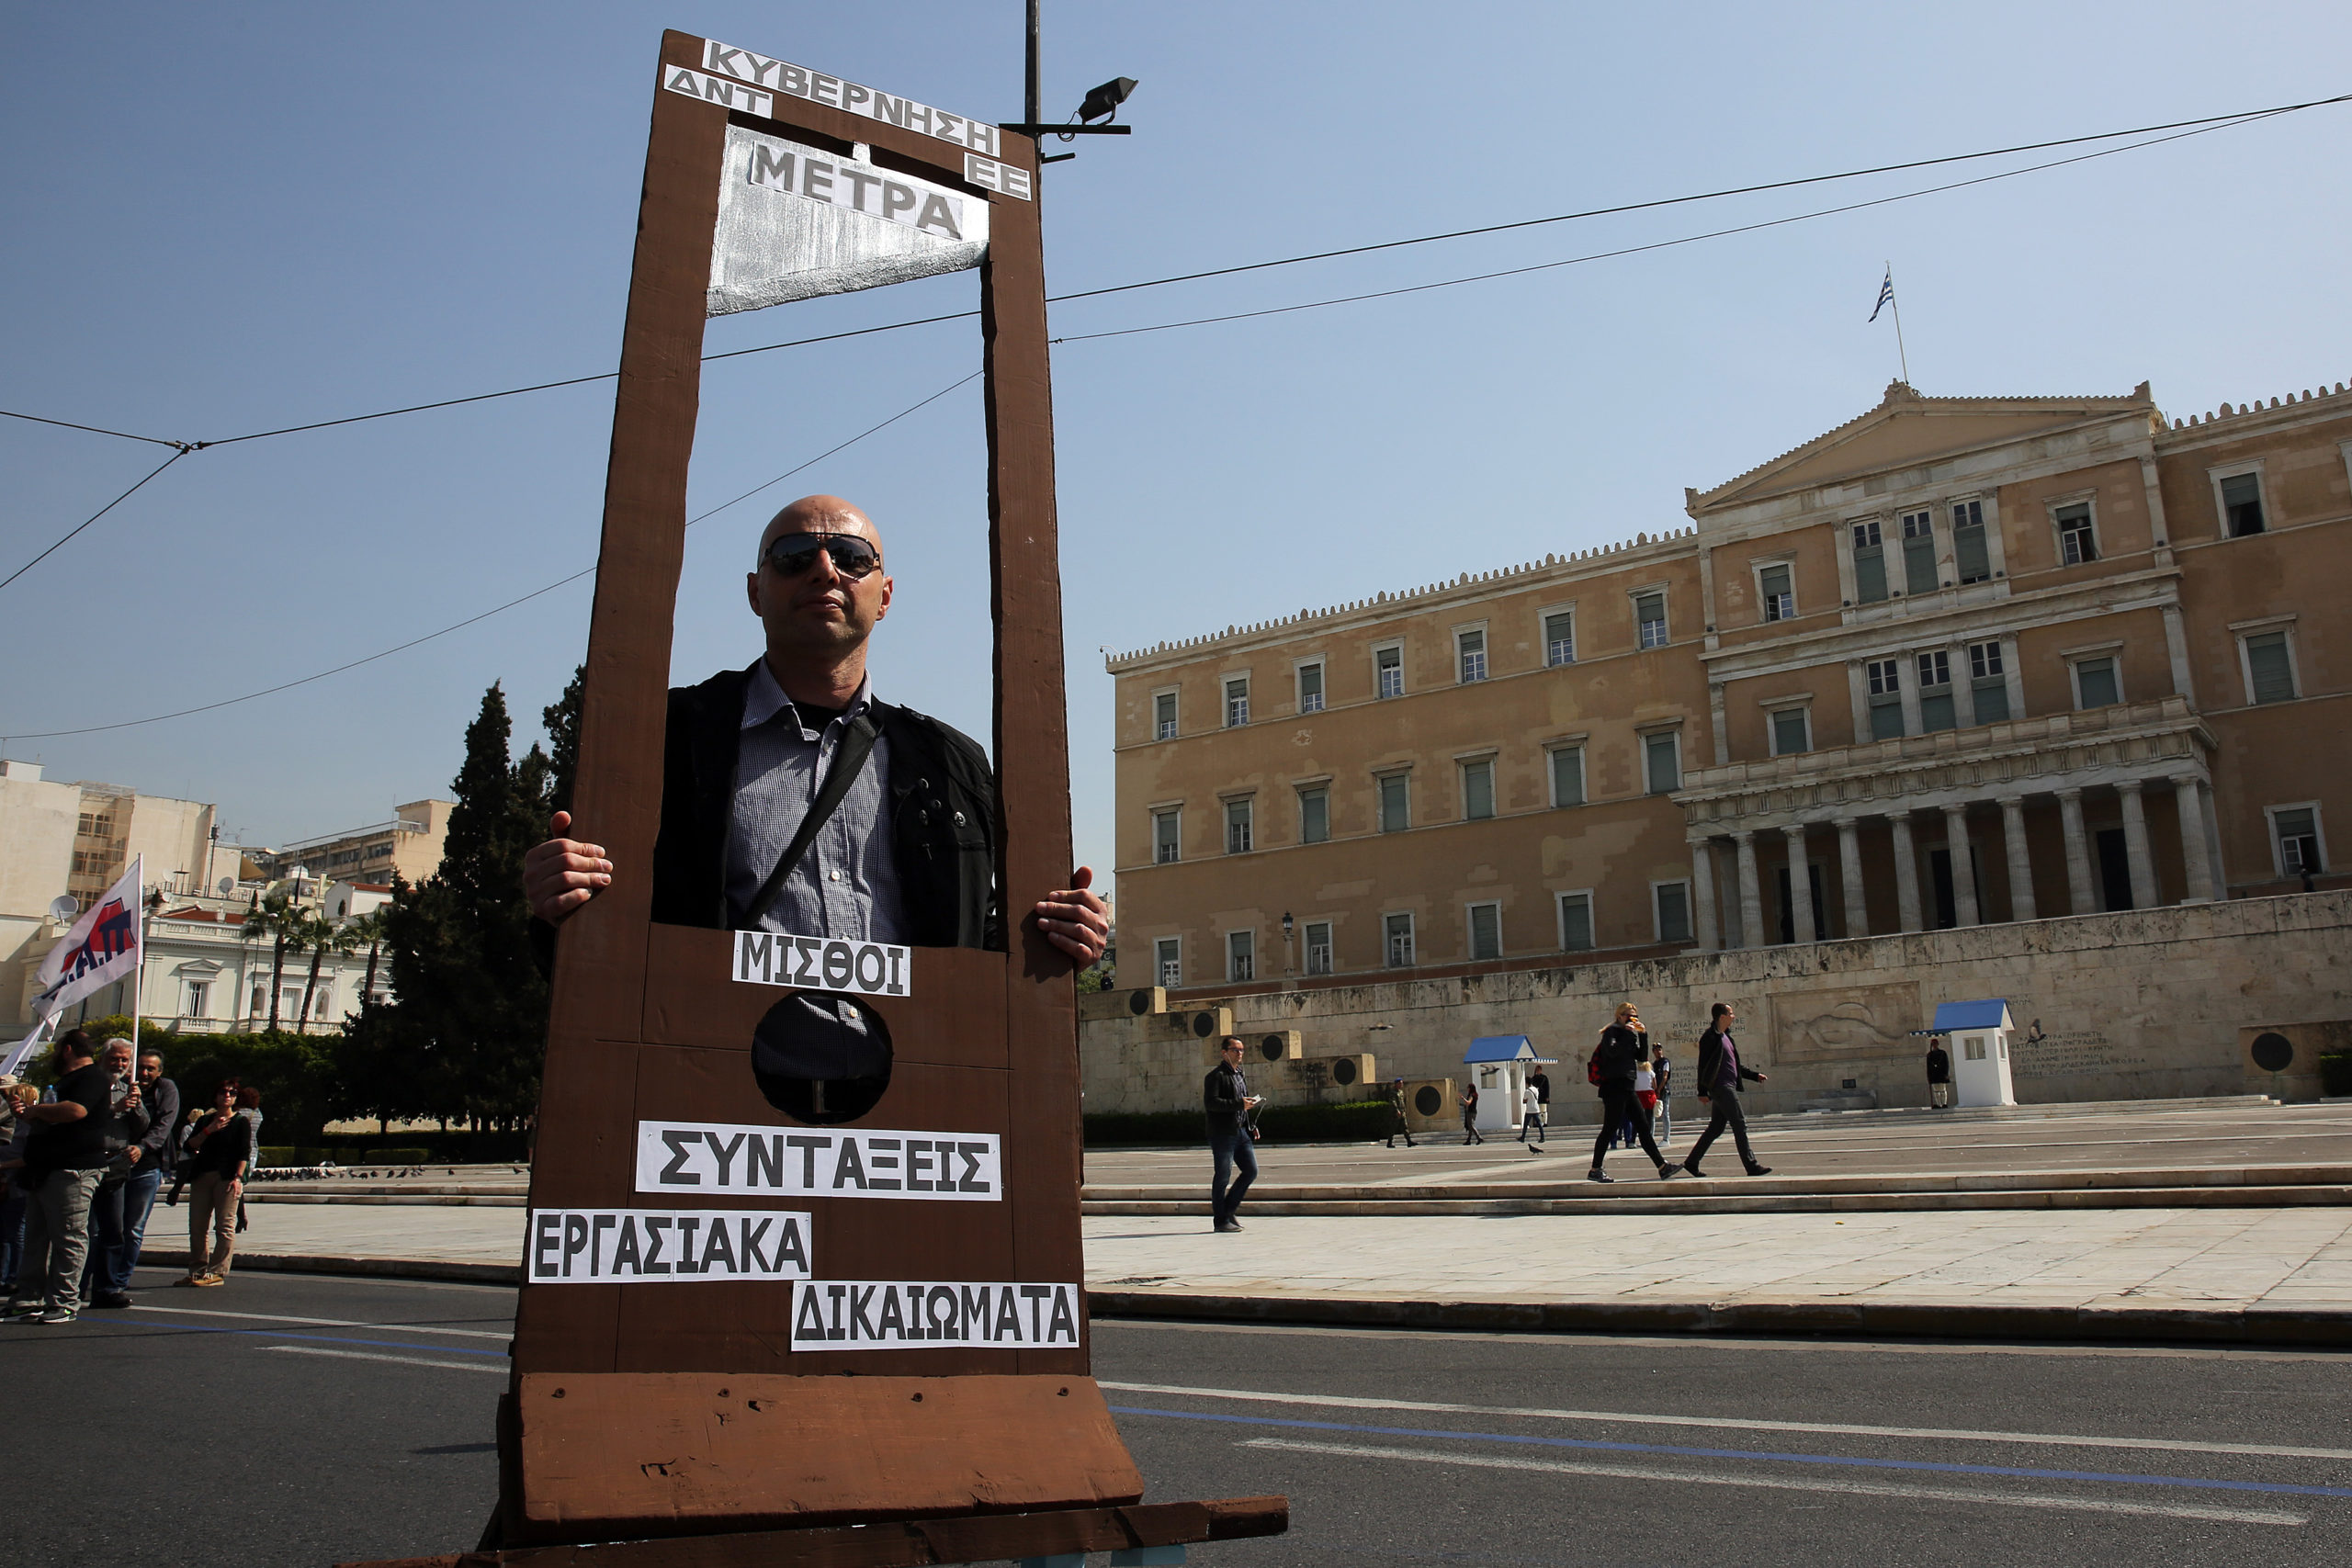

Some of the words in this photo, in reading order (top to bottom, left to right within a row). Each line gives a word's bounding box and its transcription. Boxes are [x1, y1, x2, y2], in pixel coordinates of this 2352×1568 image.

[668, 68, 770, 113] ΔΝΤ
[707, 42, 995, 154] ΚΥΒΕΡΝΗΣΗ
[753, 144, 960, 239] ΜΕΤΡΑ
[967, 154, 1030, 199] ΕΕ
[741, 932, 904, 994] ΜΙΣΘΟΙ
[660, 1131, 990, 1192] ΣΥΝΤΑΞΕΙΣ
[535, 1215, 809, 1277] ΕΡΓΑΣΙΑΚΑ
[795, 1286, 1077, 1343] ΔΙΚΑΙΩΜΑΤΑ
